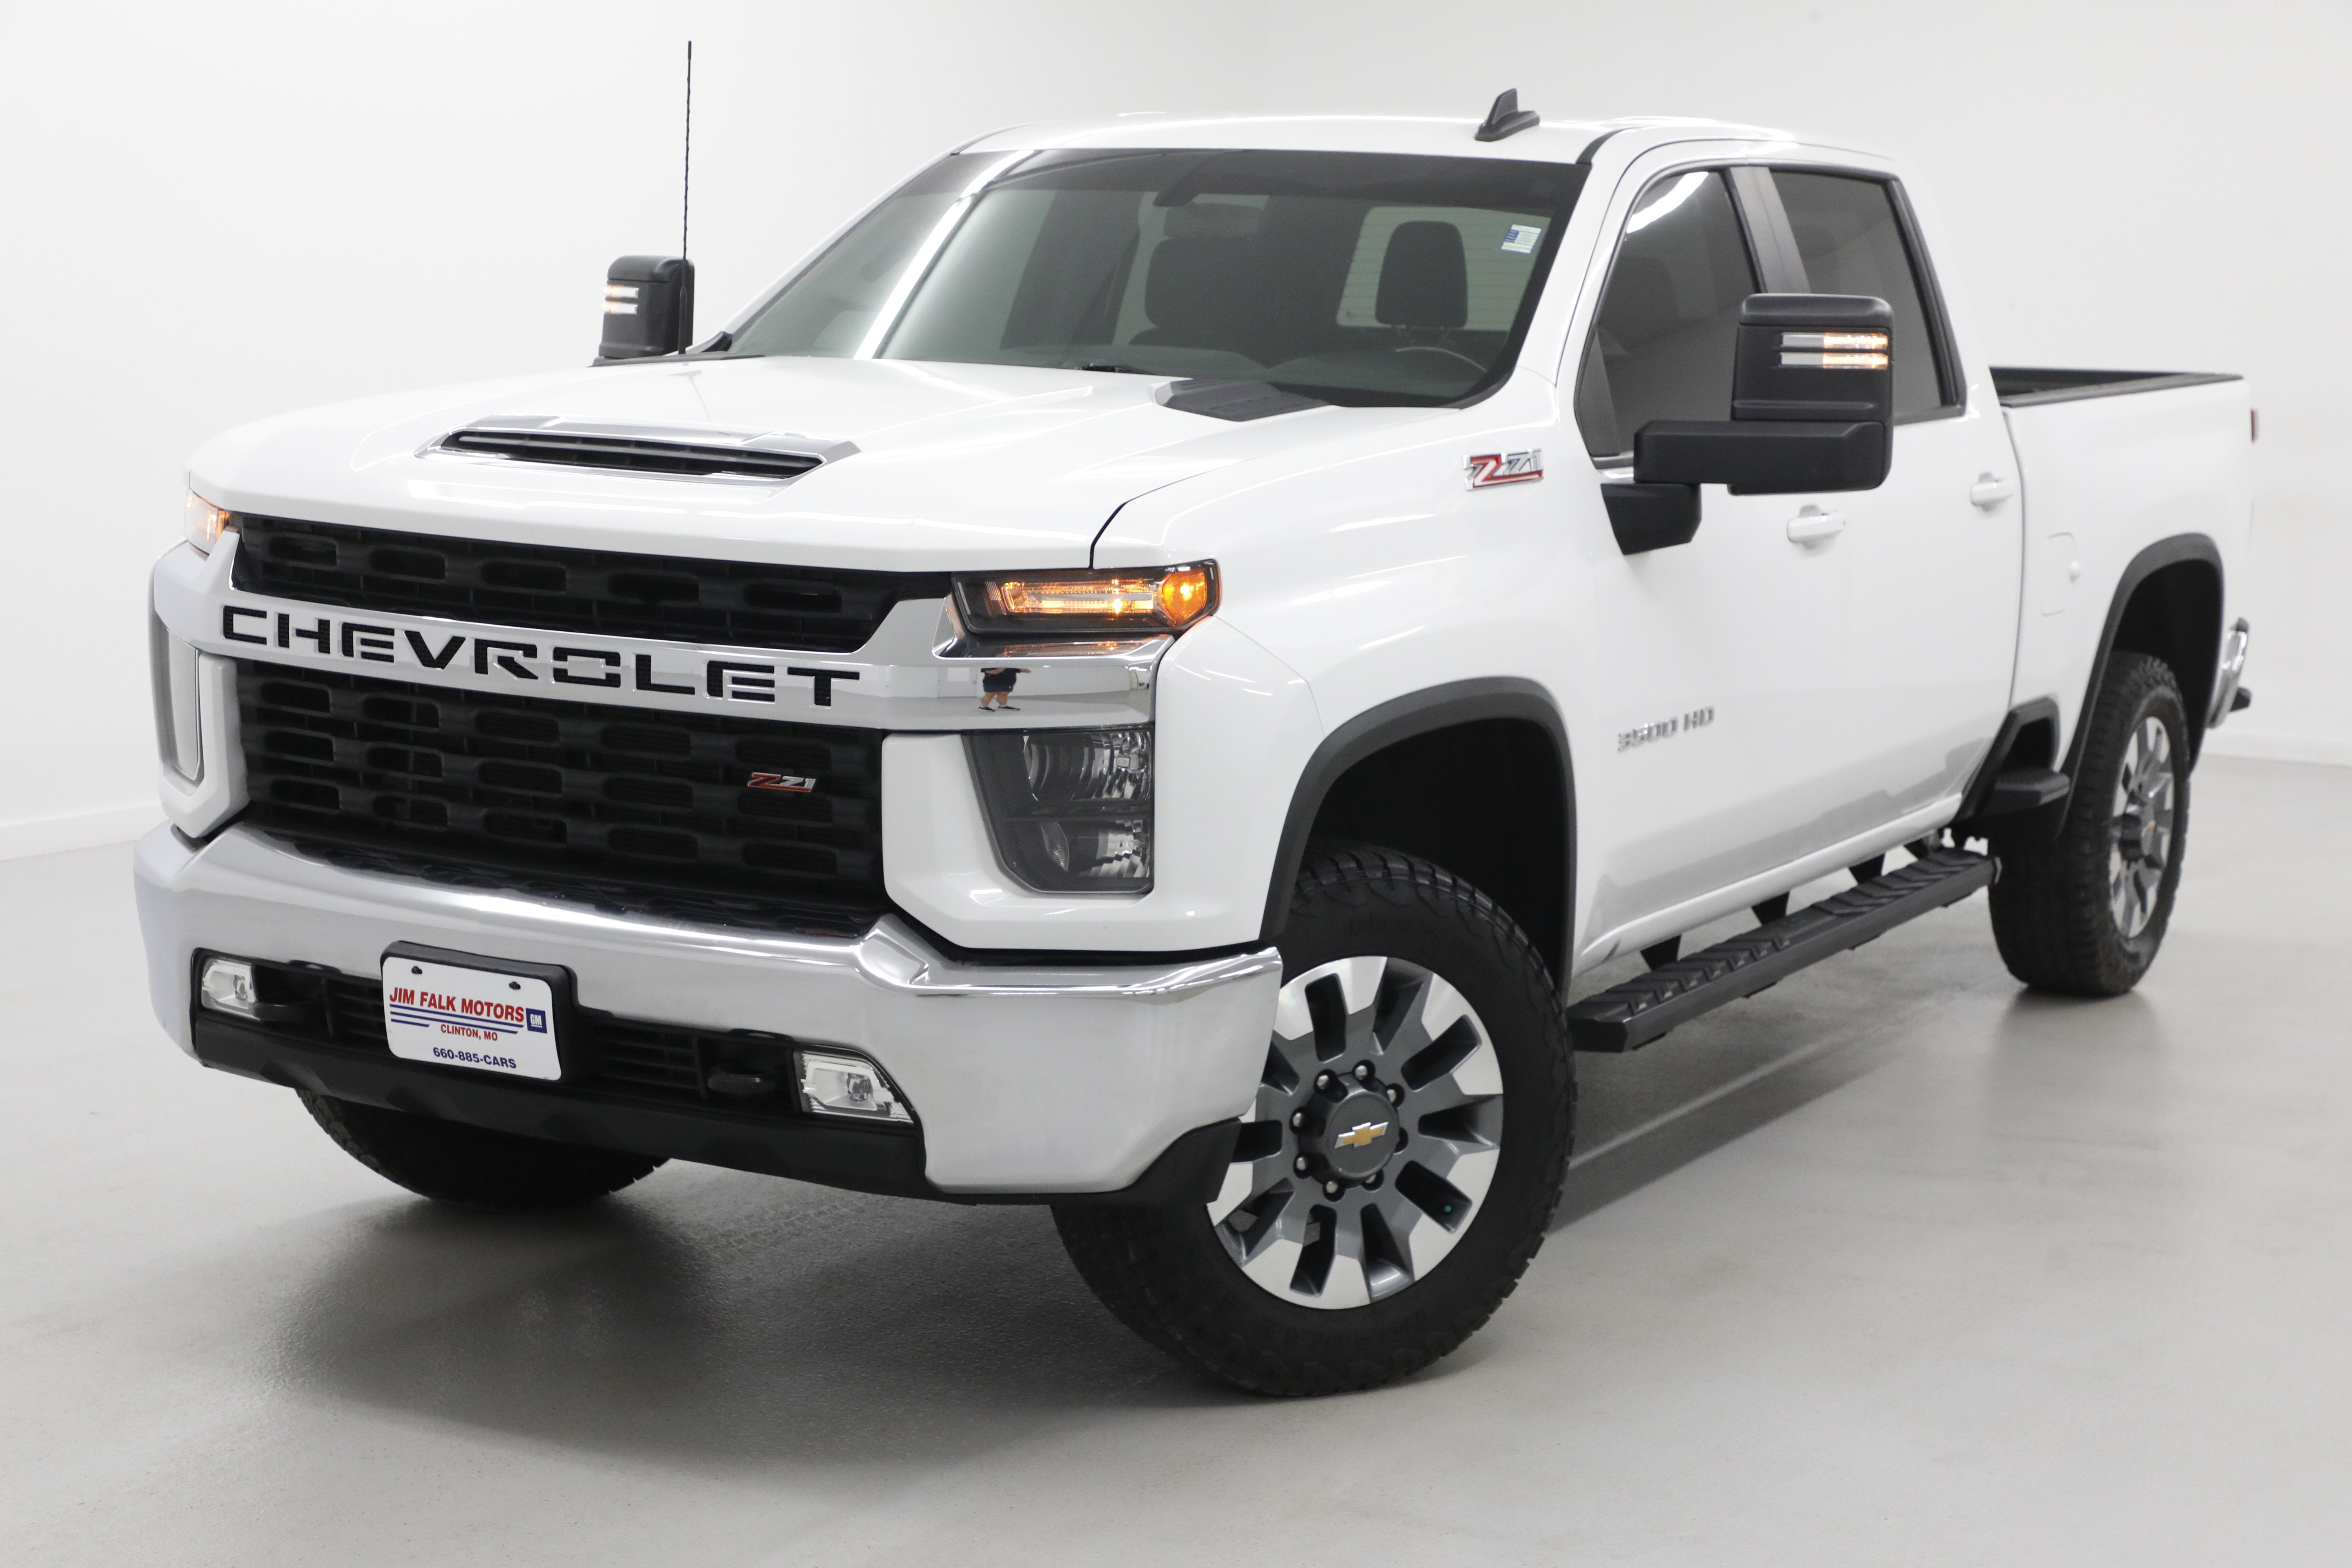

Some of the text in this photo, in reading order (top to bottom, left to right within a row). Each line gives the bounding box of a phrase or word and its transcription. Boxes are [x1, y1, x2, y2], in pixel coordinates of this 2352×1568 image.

[1463, 448, 1544, 491] Z71
[222, 605, 860, 707] CHEVROLET
[1617, 705, 1715, 753] 3500 HD
[747, 772, 816, 793] Z71
[389, 987, 525, 1022] JIM FALK MOTORS
[441, 1024, 498, 1041] CLINTON, MO
[530, 1013, 542, 1026] GM
[433, 1047, 517, 1069] 660-885-CARS
